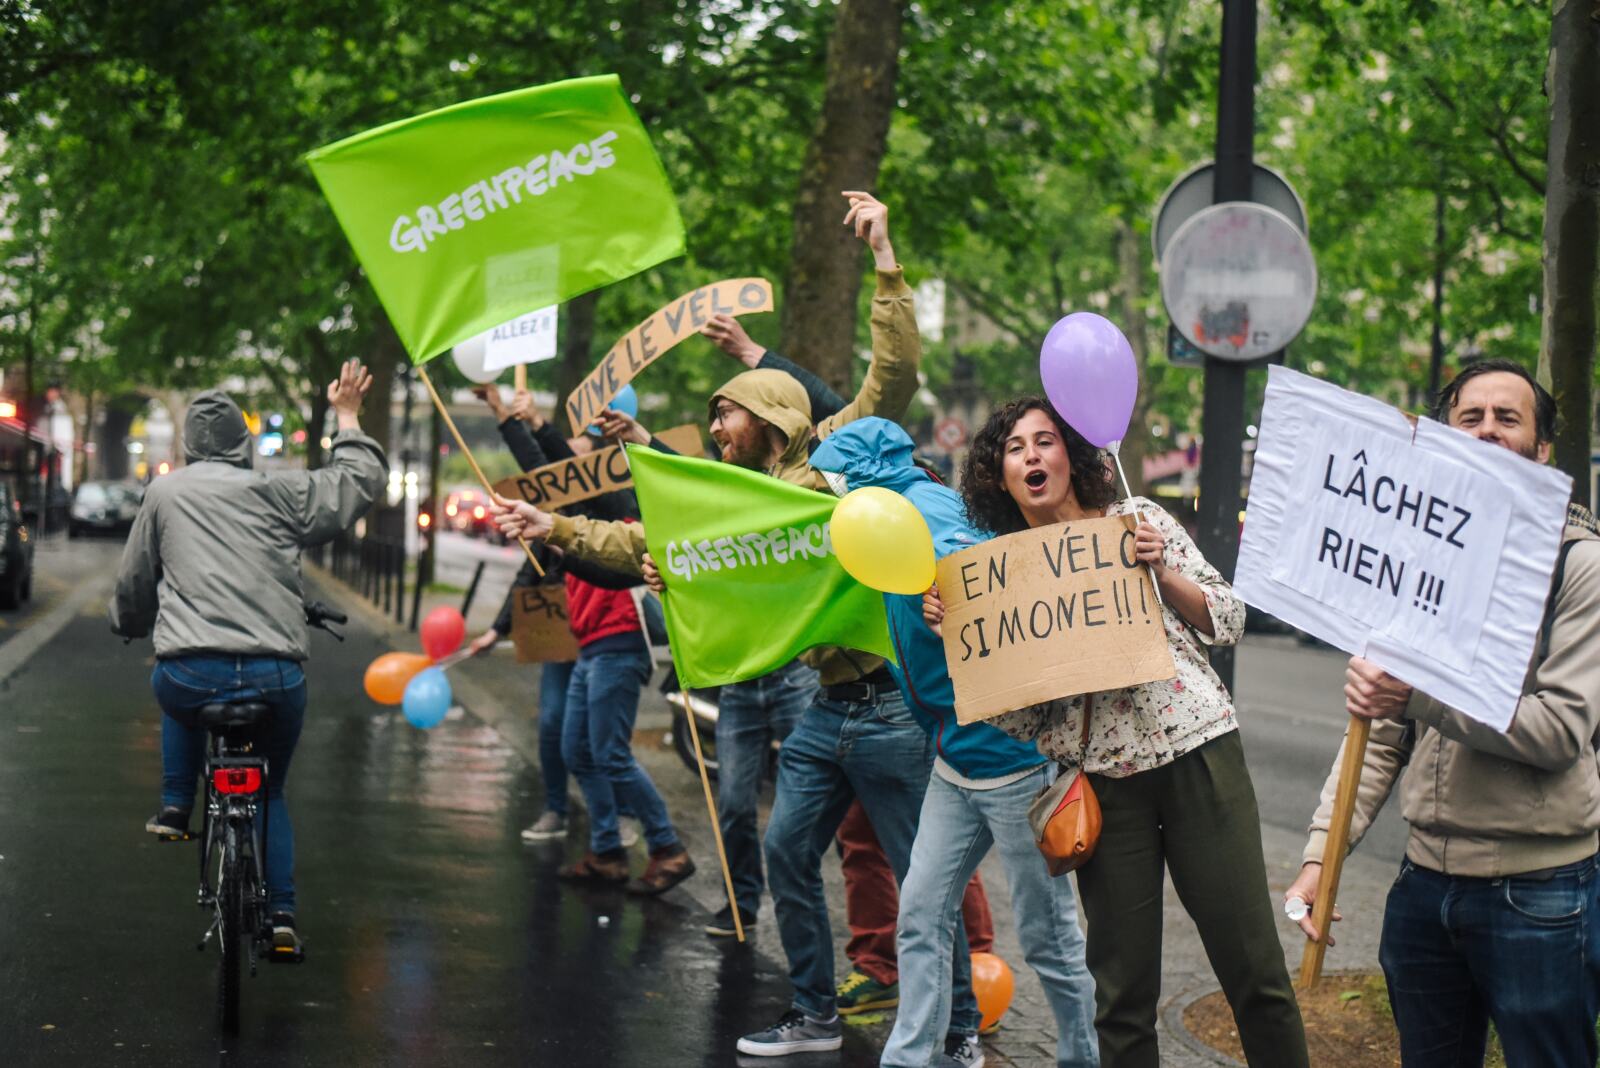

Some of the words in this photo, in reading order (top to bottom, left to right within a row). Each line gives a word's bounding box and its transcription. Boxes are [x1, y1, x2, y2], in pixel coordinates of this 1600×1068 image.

[389, 130, 618, 253] GREENPEACE
[491, 318, 539, 342] ALLEZ
[569, 351, 620, 427] VIVE
[626, 318, 658, 373] LE
[517, 448, 632, 505] BRAVO
[1322, 449, 1472, 549] LÂCHEZ
[961, 551, 1007, 601] EN
[1042, 526, 1138, 578] VÉLO
[1318, 526, 1405, 598] RIEN
[1413, 570, 1445, 616] !!!
[960, 577, 1151, 662] SIMONE!!!
